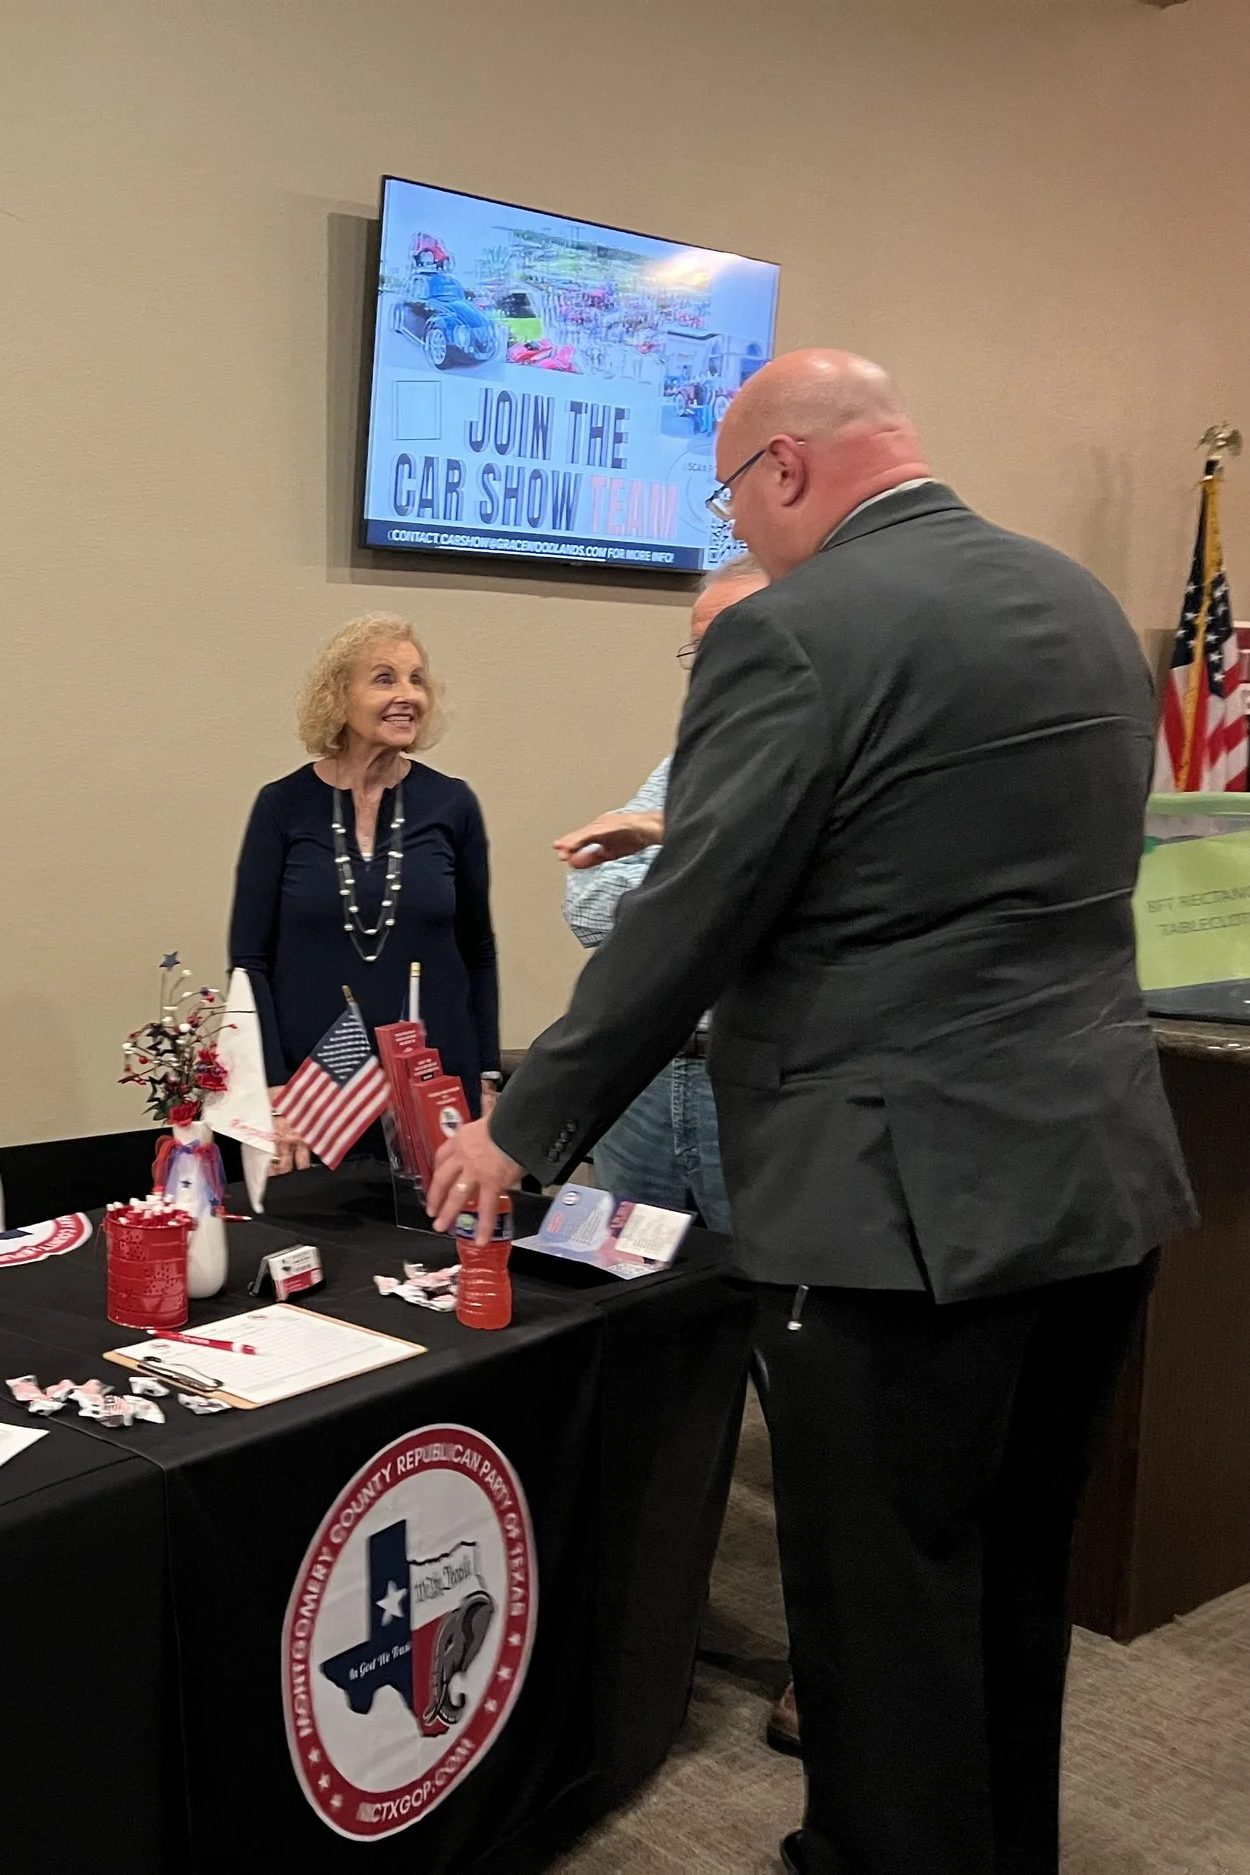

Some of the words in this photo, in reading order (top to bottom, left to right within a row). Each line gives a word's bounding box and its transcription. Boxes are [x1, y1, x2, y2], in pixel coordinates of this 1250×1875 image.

[465, 387, 555, 461] JOIN
[566, 400, 630, 470] THE
[391, 452, 466, 522] CAR
[477, 462, 583, 532] SHOW
[590, 474, 679, 541] TEAM
[607, 547, 625, 559] FOR
[625, 549, 651, 561] MORE
[329, 1462, 392, 1544] COUNTY
[396, 1443, 481, 1476] REPUBLICAN
[479, 1462, 512, 1510] PARTY
[358, 1657, 377, 1679] God
